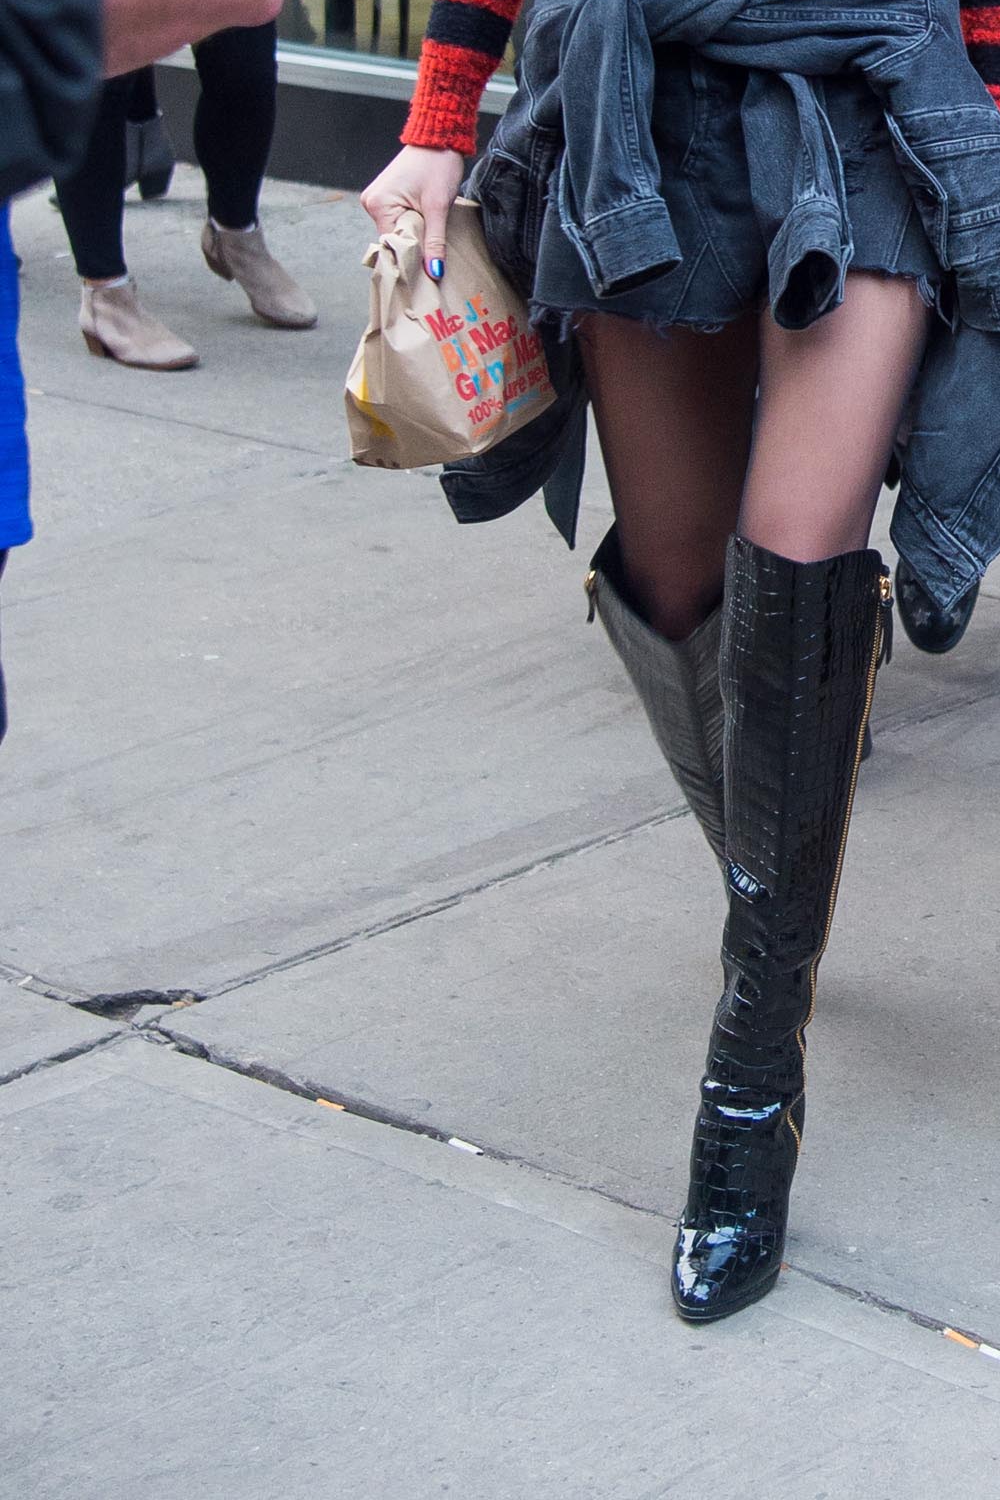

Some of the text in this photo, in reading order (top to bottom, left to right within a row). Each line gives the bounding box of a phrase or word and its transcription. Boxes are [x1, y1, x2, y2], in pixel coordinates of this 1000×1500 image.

[424, 293, 489, 342] Mac Jr.
[440, 315, 518, 373] Big Mac
[466, 395, 504, 426] 100%
